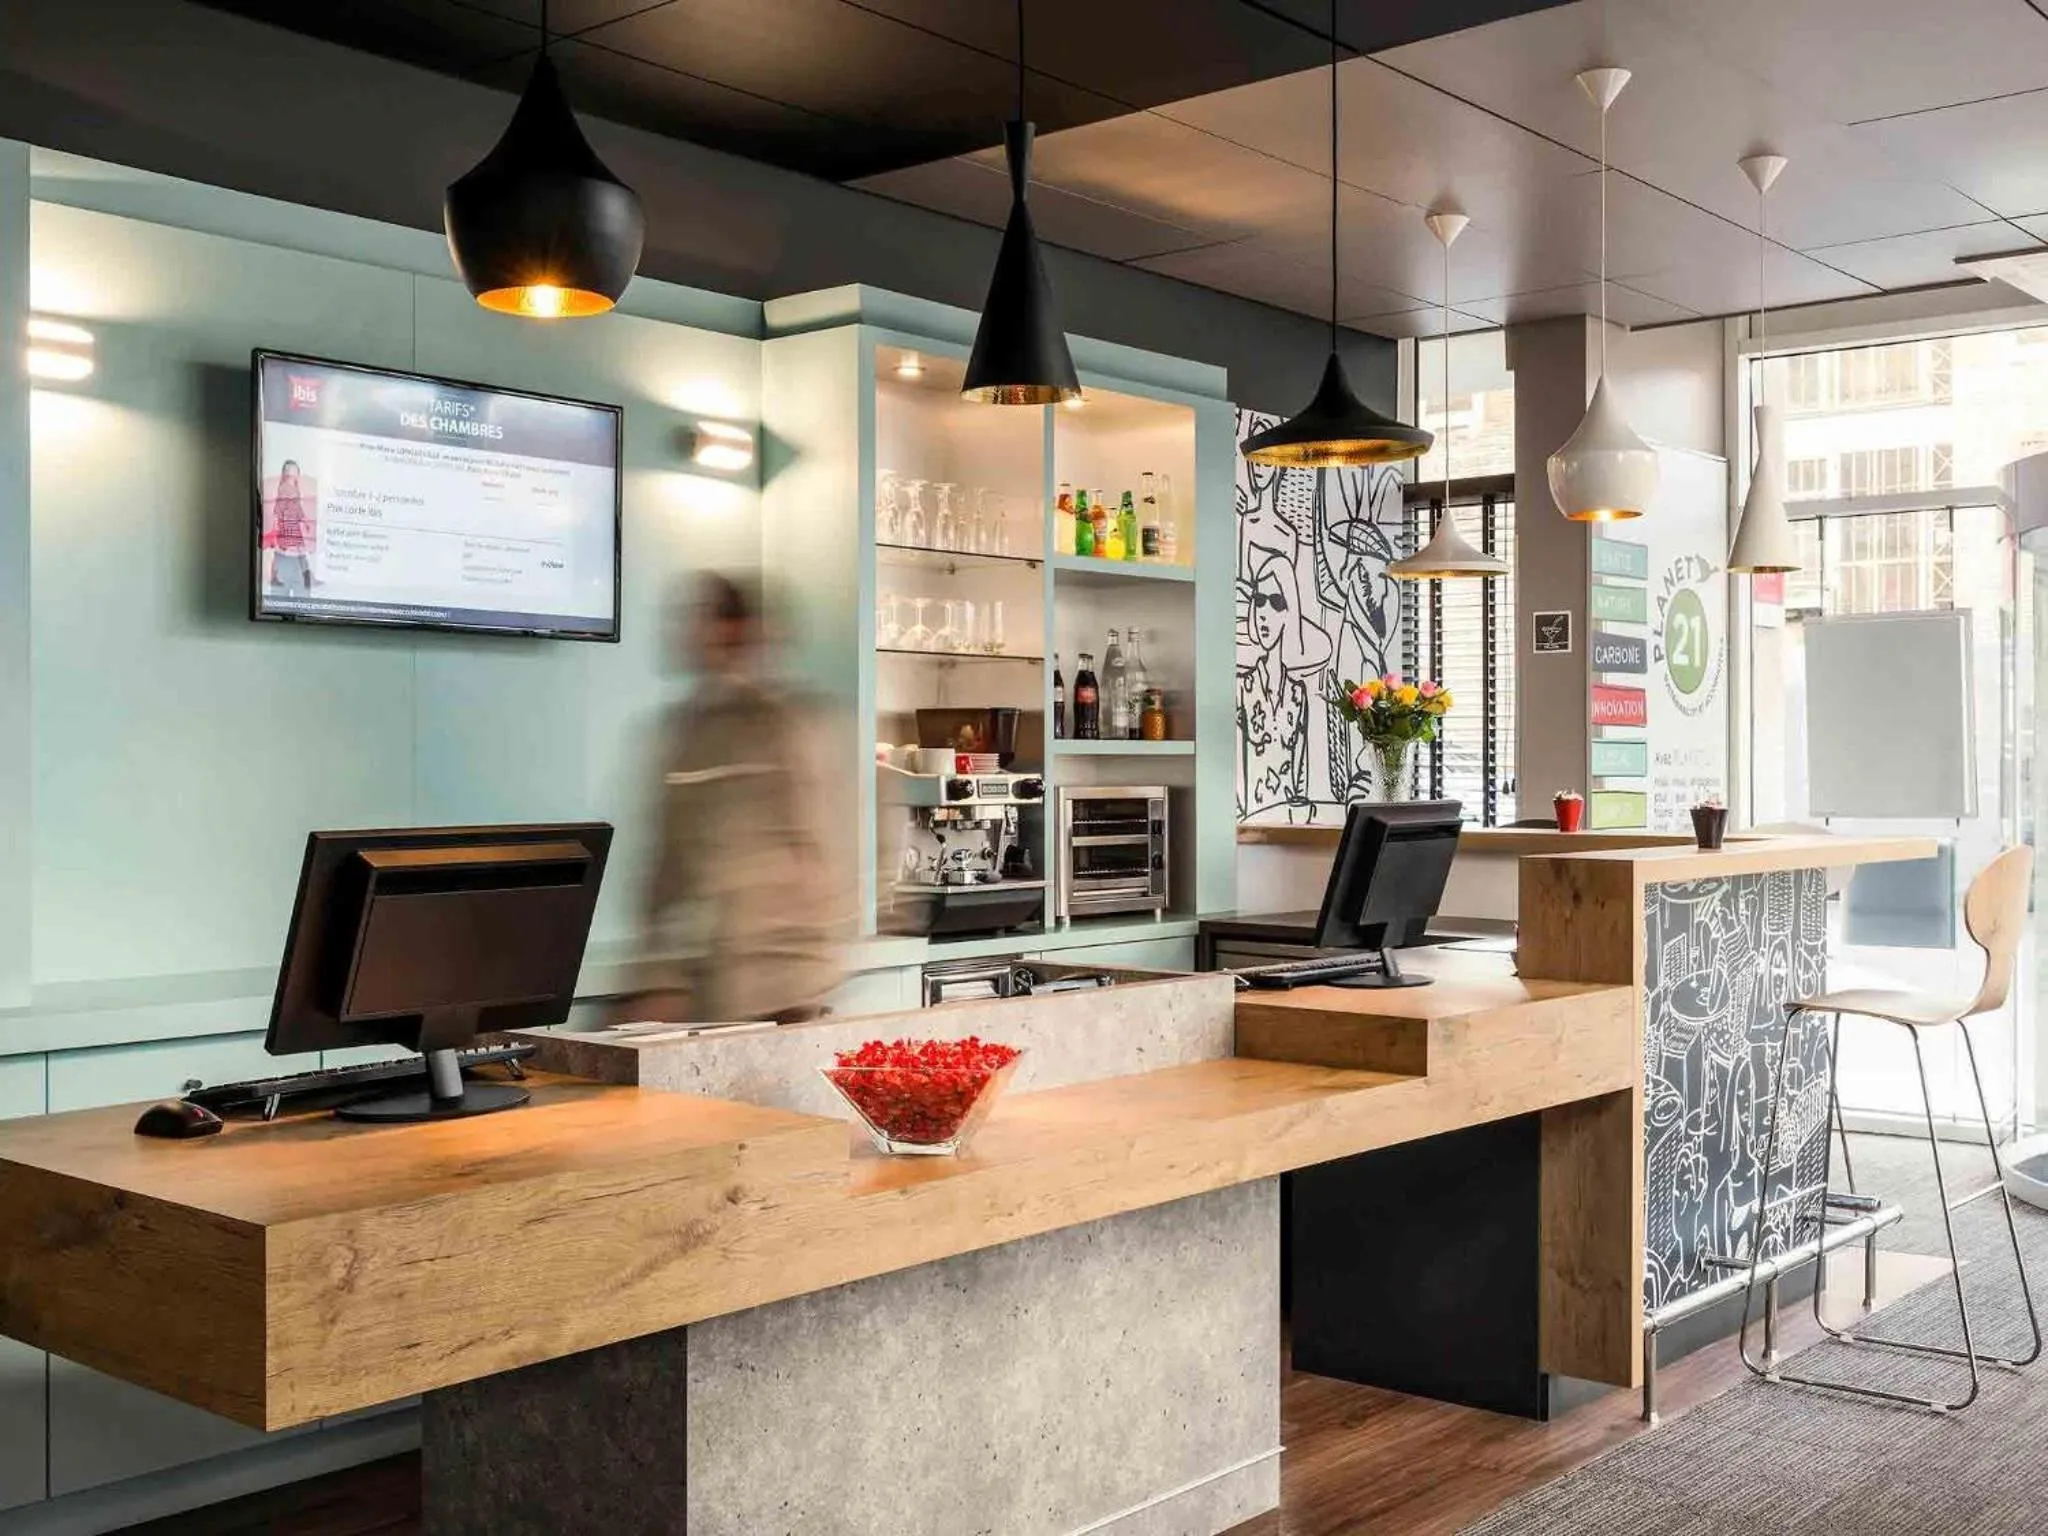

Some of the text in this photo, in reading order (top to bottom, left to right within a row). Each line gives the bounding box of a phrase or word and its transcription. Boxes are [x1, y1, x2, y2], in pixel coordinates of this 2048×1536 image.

[400, 412, 504, 439] DES CHAMBRES
[1653, 556, 1695, 664] PLANET
[1672, 612, 1701, 669] 21
[1594, 644, 1641, 665] CARBONE
[1592, 699, 1645, 717] INNOVATION
